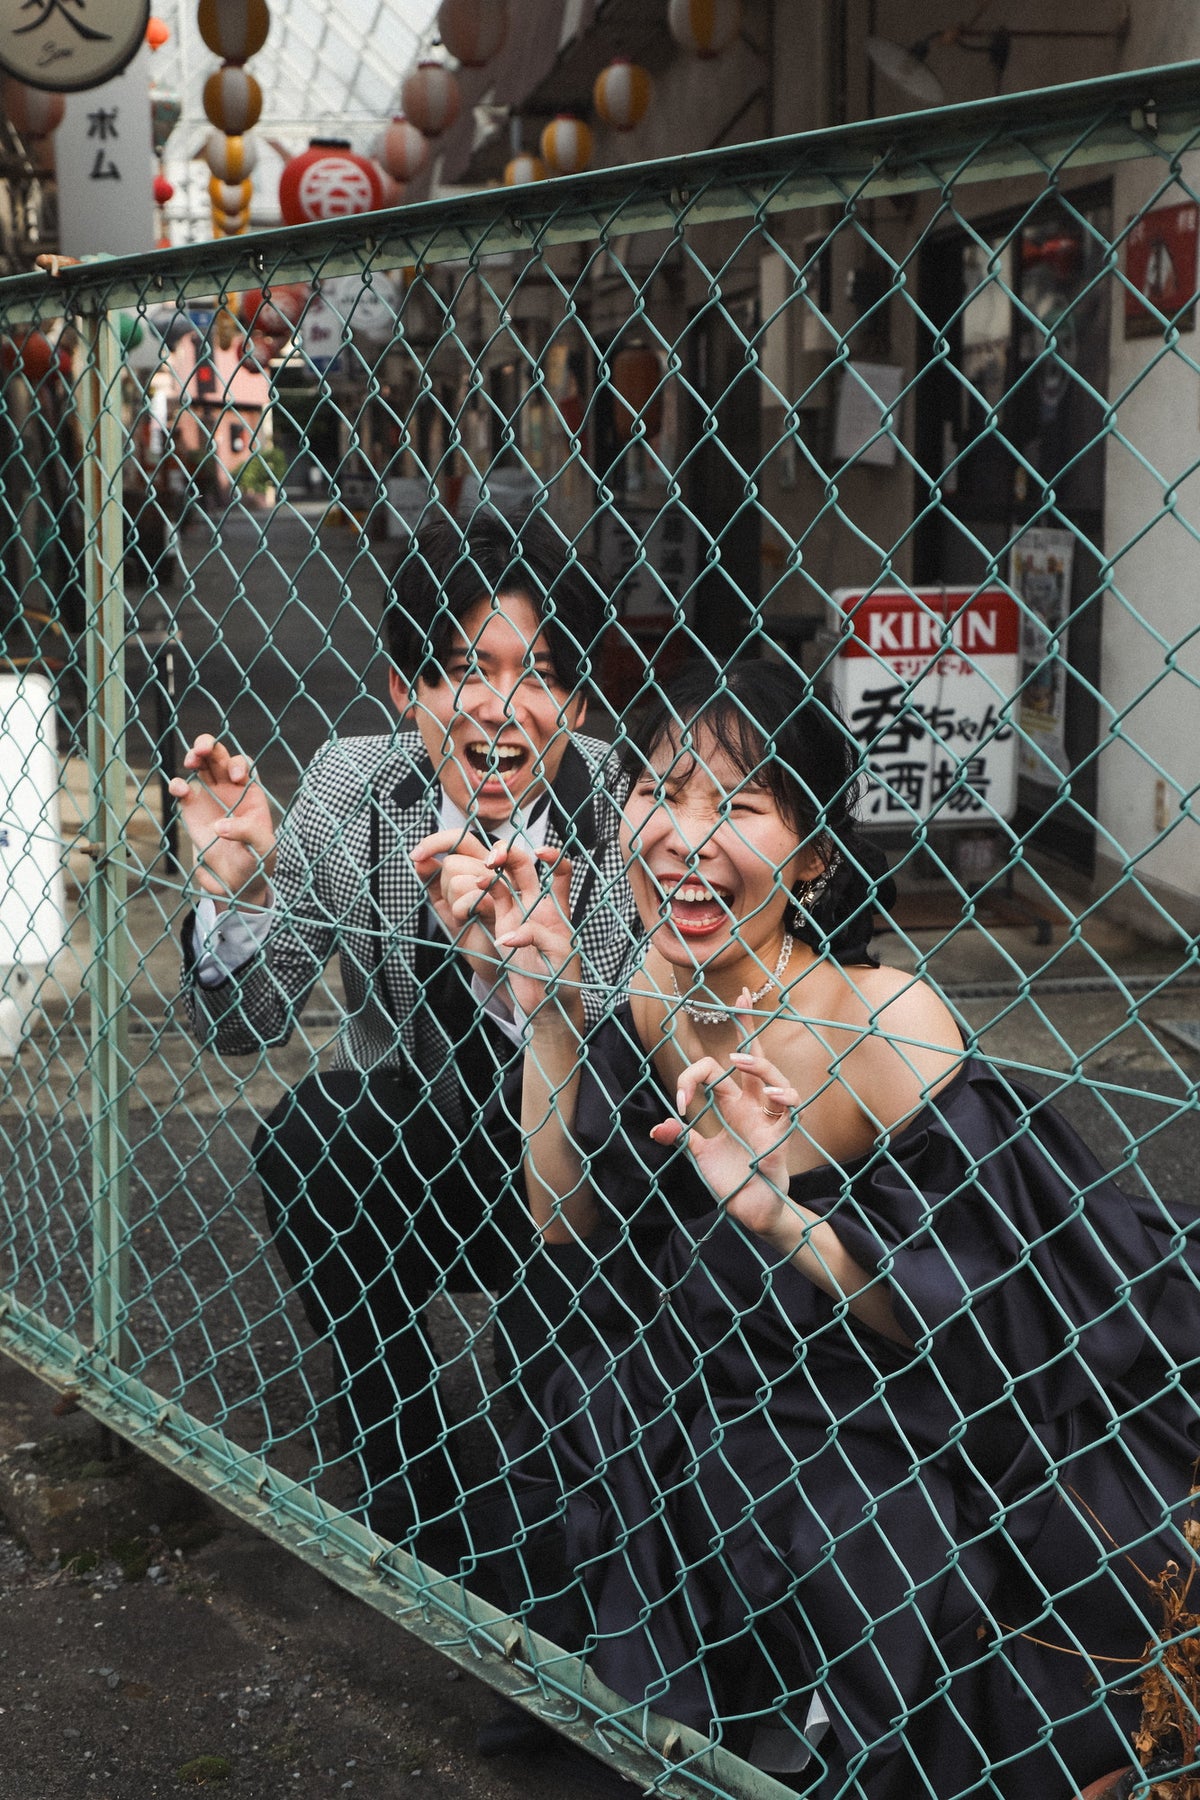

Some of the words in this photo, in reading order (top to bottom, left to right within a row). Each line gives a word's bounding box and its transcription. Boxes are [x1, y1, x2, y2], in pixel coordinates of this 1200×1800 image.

[868, 610, 997, 650] KIRIN
[851, 680, 1013, 755] 呑ちゃん
[868, 757, 990, 815] 酒場
